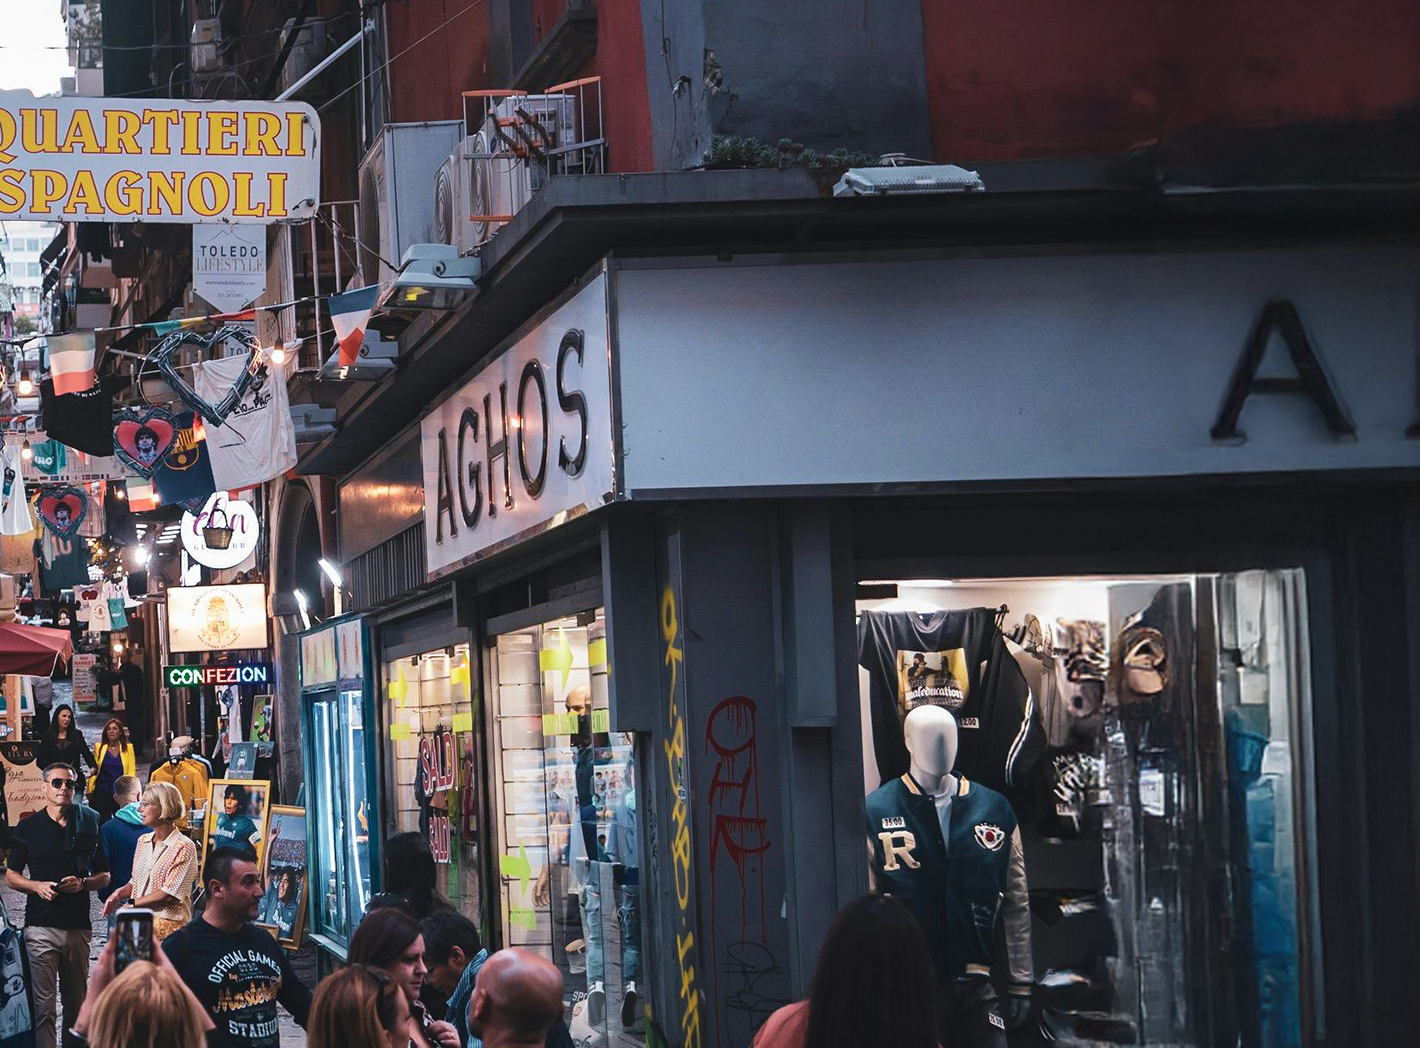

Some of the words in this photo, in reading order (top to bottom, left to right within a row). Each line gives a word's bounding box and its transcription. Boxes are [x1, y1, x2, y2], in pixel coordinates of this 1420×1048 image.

[197, 258, 264, 271] LIFESTYLE
[200, 245, 258, 257] TOLEDO
[435, 327, 590, 545] AGHOS
[193, 542, 246, 551] GLUR
[170, 666, 267, 685] CONFEZION
[421, 731, 459, 797] SALDI
[428, 816, 452, 864] SALDI
[878, 830, 921, 871] R
[208, 949, 248, 984] OFFICIAL
[247, 949, 282, 975] GAMES
